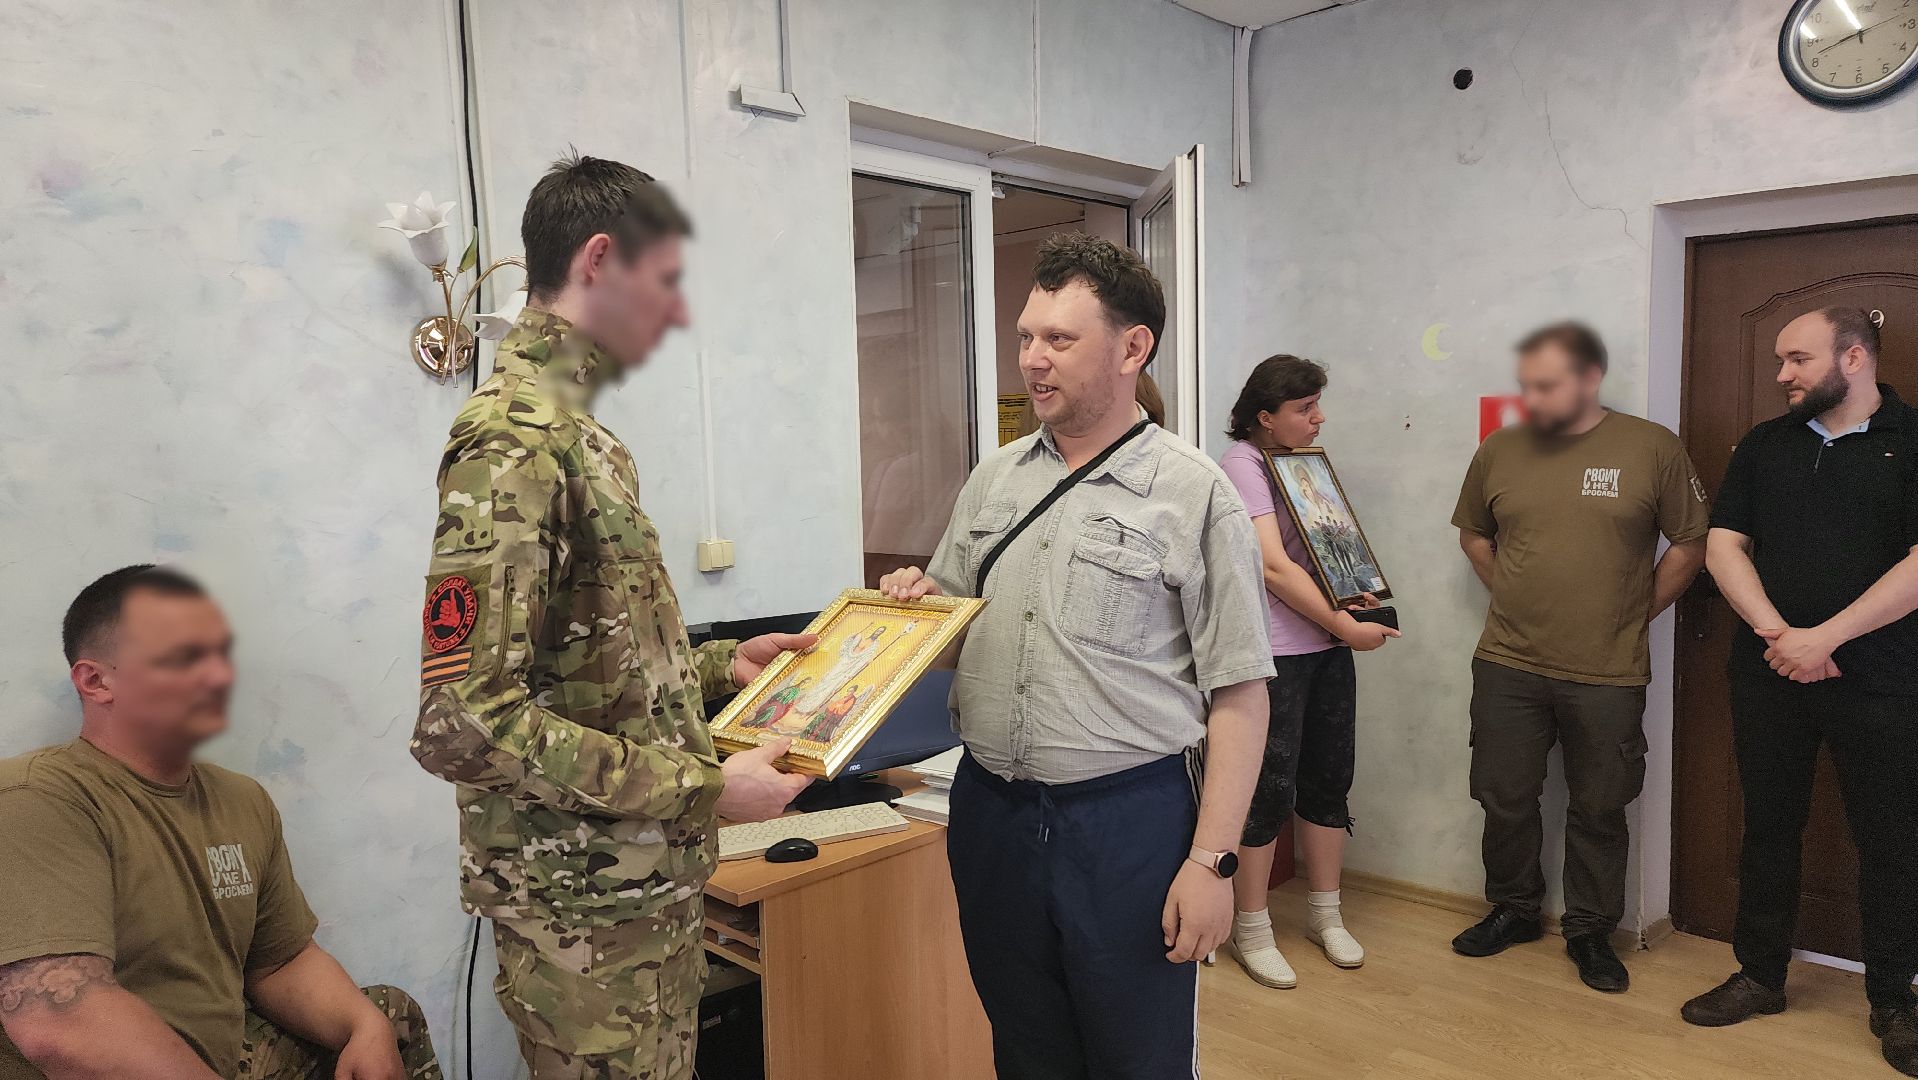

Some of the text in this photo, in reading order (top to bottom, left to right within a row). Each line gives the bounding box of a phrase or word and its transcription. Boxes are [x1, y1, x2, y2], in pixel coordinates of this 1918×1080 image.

[1810, 13, 1822, 23] 10
[1908, 18, 1917, 29] 3
[1899, 42, 1907, 52] 4
[1811, 57, 1819, 67] 8
[1882, 63, 1889, 73] 5
[1830, 72, 1837, 82] 7
[1855, 73, 1863, 83] 6
[1869, 309, 1885, 328] 9
[1582, 467, 1621, 491] СВОИХ
[1592, 482, 1609, 490] НЕ
[1581, 489, 1619, 498] БРОСАЕМ
[849, 763, 861, 772] AOC
[205, 843, 252, 887] СВОИХ
[222, 871, 241, 885] НЕ
[212, 883, 254, 900] БРОСАЕМ
